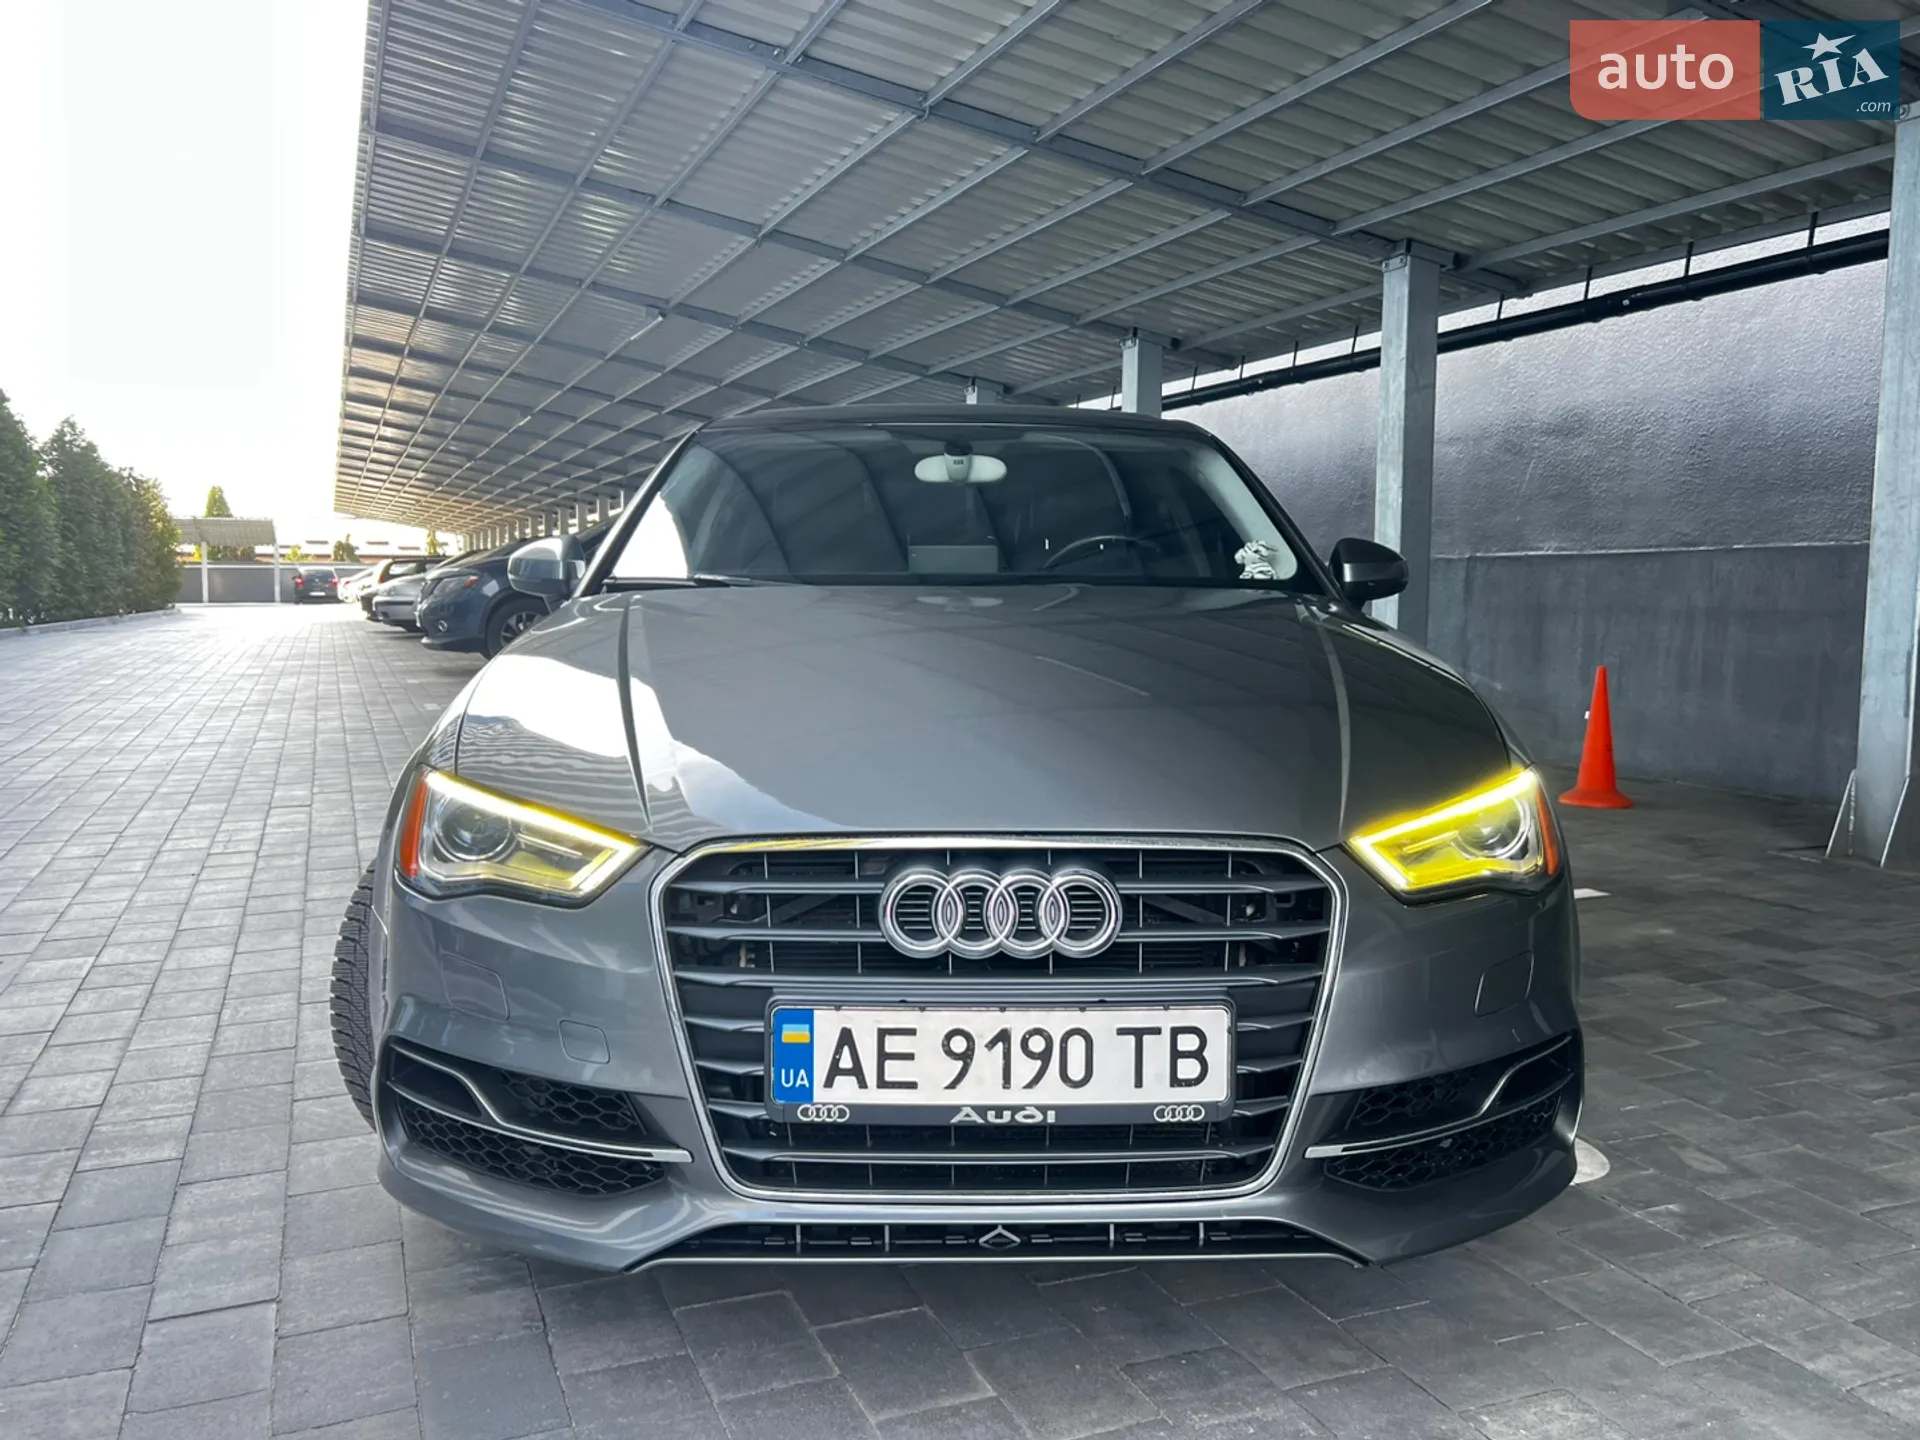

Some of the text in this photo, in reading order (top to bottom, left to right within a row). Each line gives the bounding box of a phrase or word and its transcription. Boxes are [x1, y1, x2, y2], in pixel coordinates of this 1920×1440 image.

[822, 1026, 1210, 1090] AE 9190 TB
[780, 1068, 810, 1089] UA
[950, 1105, 1057, 1125] Audi
